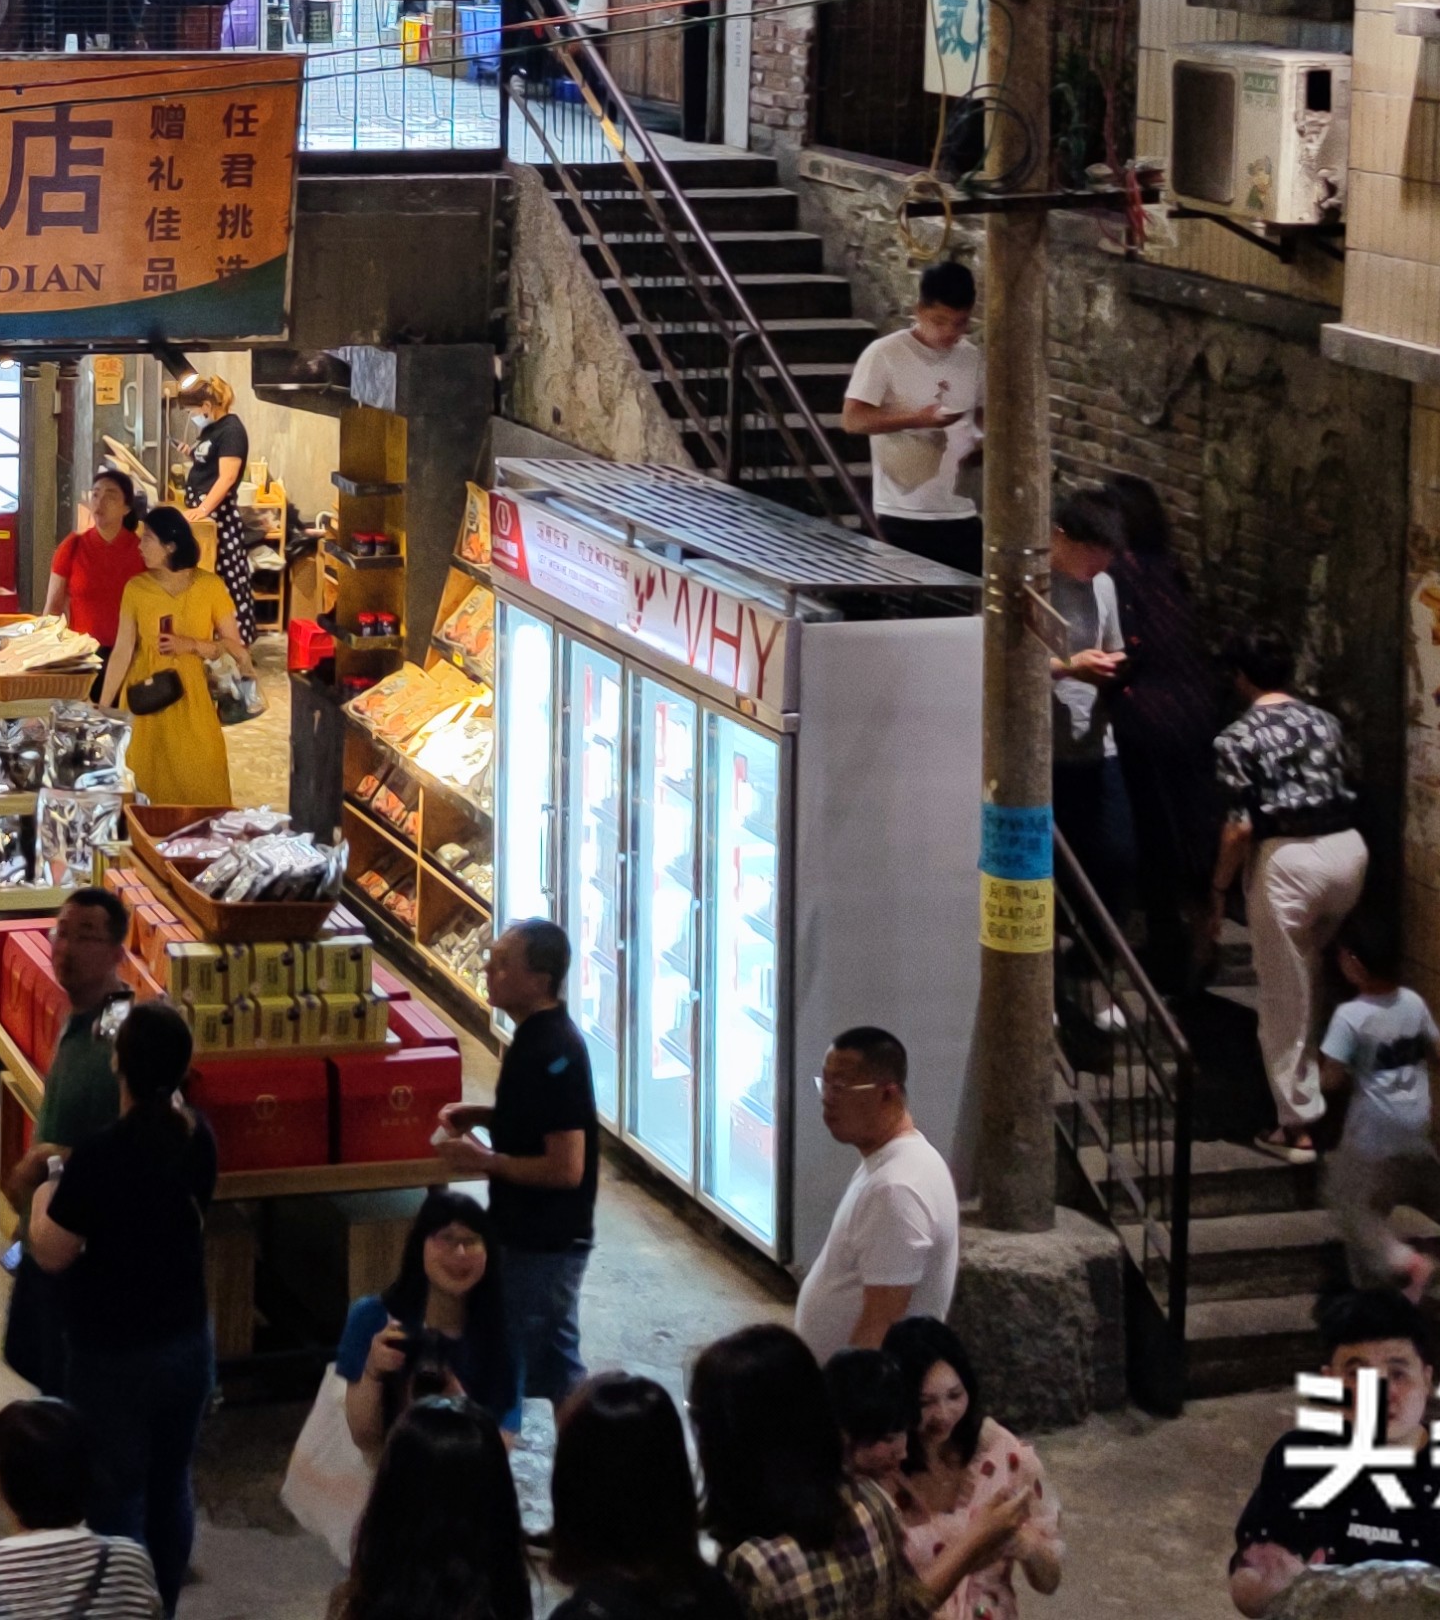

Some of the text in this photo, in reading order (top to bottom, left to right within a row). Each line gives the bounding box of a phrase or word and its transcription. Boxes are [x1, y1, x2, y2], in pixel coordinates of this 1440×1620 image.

[141, 103, 187, 295] 赠礼佳品
[213, 100, 261, 286] 任君挑选
